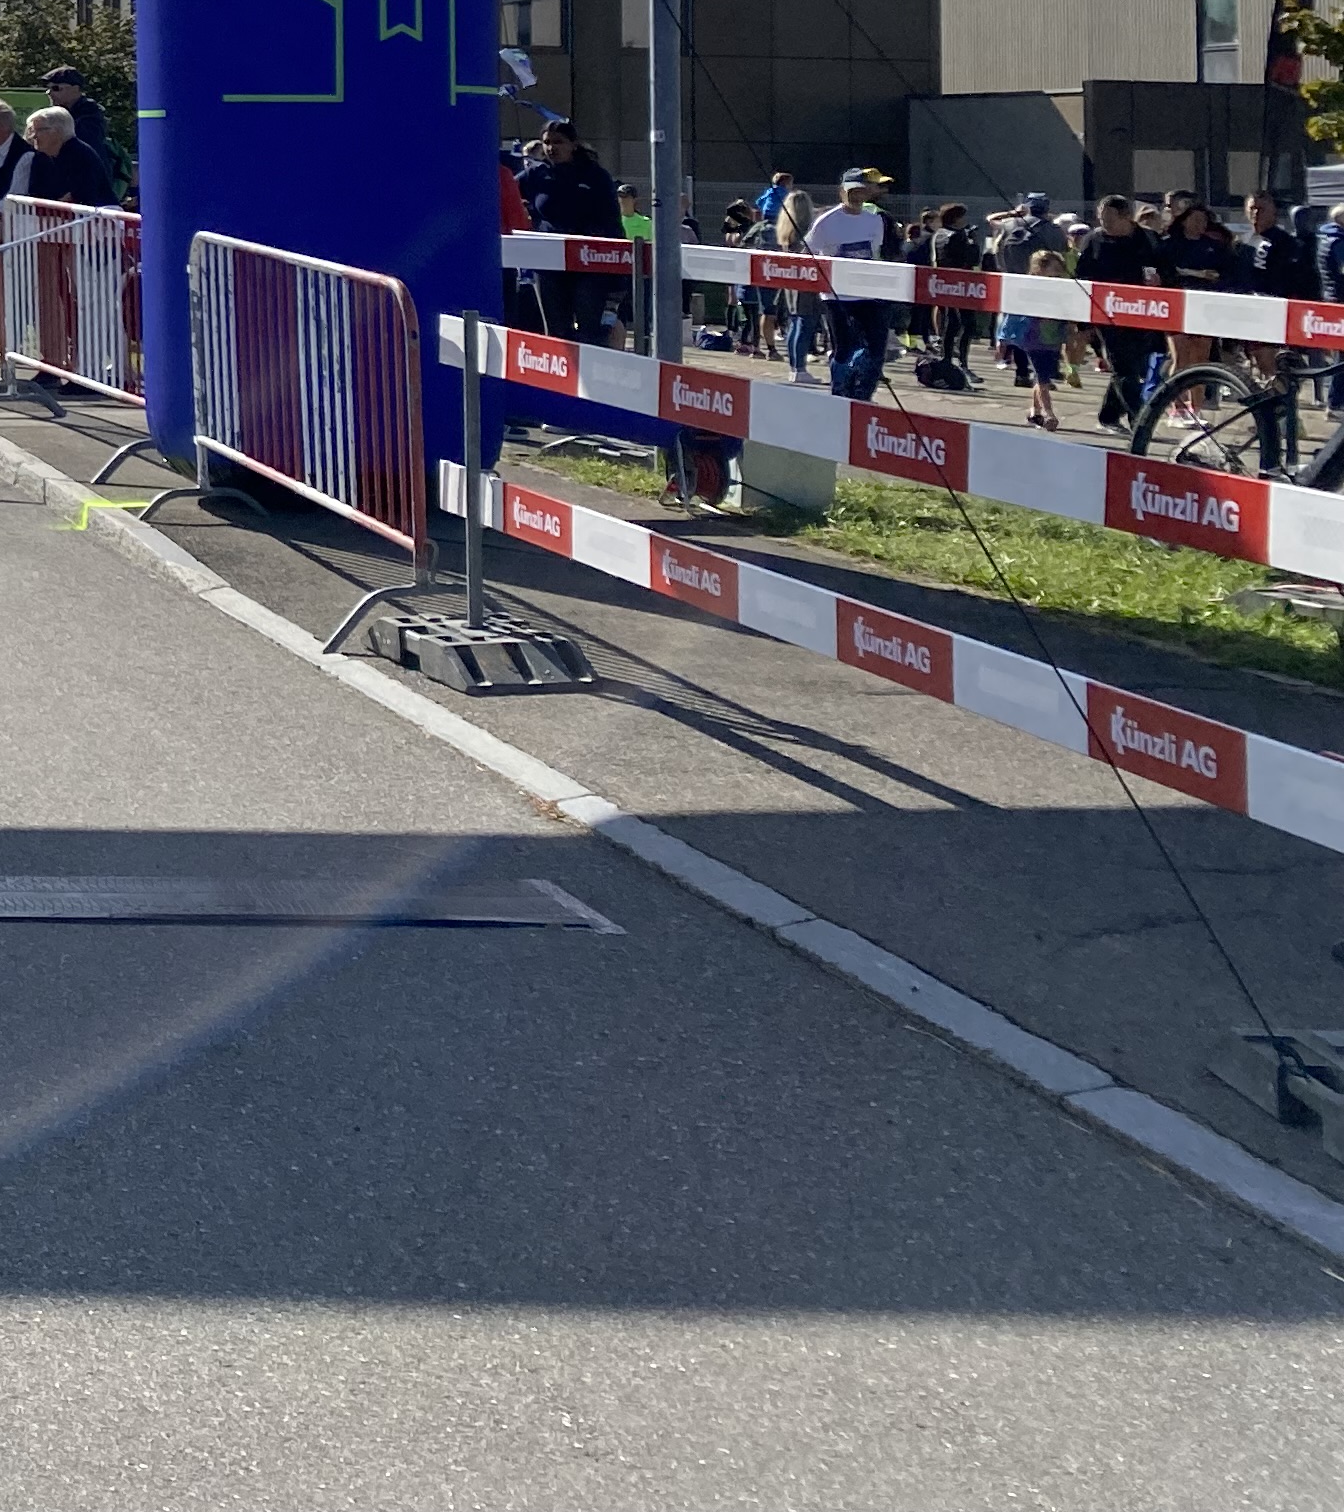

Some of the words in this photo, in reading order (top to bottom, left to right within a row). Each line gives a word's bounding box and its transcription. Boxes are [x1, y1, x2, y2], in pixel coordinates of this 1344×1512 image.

[580, 244, 616, 265] Künzli
[762, 258, 797, 281] Künzli
[799, 266, 818, 281] AG
[928, 274, 965, 297] Künzli
[966, 283, 986, 299] AG
[1105, 291, 1146, 317] Künzli
[1147, 300, 1169, 318] AG
[518, 341, 549, 374] Künzli
[549, 354, 567, 378] AG
[673, 375, 710, 411] Künzli
[712, 391, 733, 416] AG
[867, 416, 916, 459] Künzli
[918, 436, 945, 465] AG
[513, 496, 543, 530] Künzli
[544, 514, 560, 537] AG
[1130, 472, 1199, 523] Künzli
[1202, 499, 1239, 532] AG
[662, 550, 700, 588] Künzli
[701, 569, 721, 596] AG
[853, 615, 902, 661] Künzli
[904, 642, 930, 674] AG
[1112, 707, 1177, 768] Künzli
[1181, 740, 1217, 779] AG
